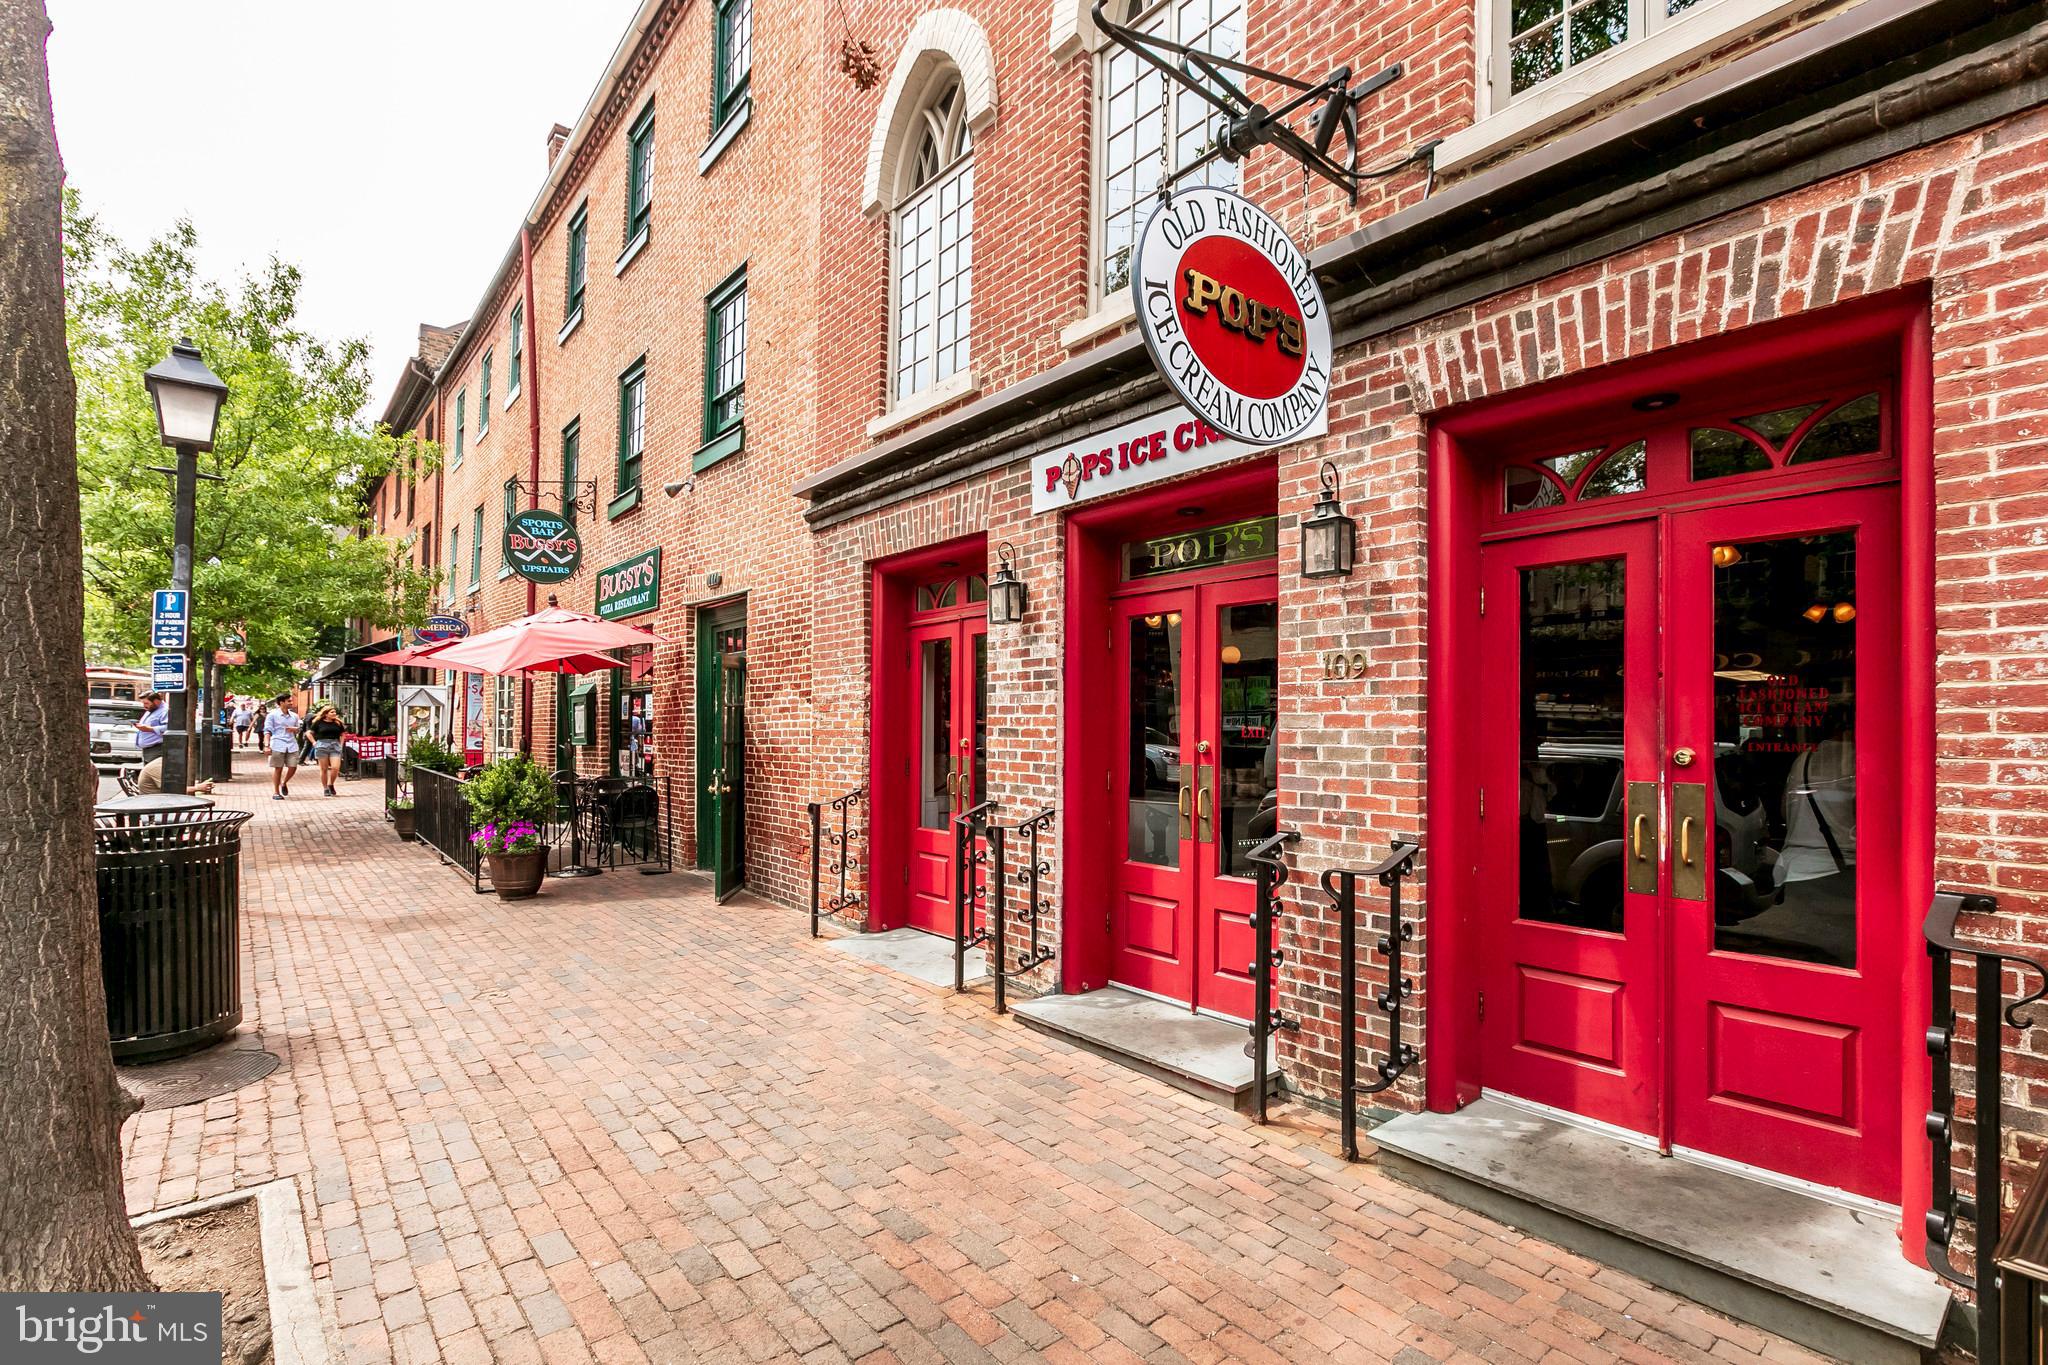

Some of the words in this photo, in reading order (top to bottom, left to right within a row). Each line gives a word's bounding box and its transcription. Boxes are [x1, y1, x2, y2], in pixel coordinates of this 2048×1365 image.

[1161, 199, 1206, 250] OLD
[1215, 197, 1319, 320] FASHIONED
[1186, 268, 1304, 355] POP'S
[1144, 276, 1179, 344] ICE
[1169, 340, 1244, 434] CREAM
[1247, 351, 1328, 439] COMPANY
[1118, 430, 1167, 470] ICE
[1173, 419, 1226, 453] CR
[521, 518, 563, 529] SPORTS
[531, 527, 556, 537] BAR
[509, 534, 578, 553] BUGSY'S
[1149, 525, 1264, 569] POP'S
[521, 565, 570, 574] UPSTAIRS
[600, 555, 654, 602] BUGSY'S
[165, 592, 176, 610] P
[614, 590, 650, 611] RESTAURANT
[1323, 652, 1367, 680] 109
[1767, 674, 1799, 686] OLD
[1739, 687, 1829, 700] FASHIONED
[1739, 701, 1765, 713] ICE
[1770, 700, 1829, 713] CREAM
[1743, 714, 1824, 728] COMPANY
[1241, 725, 1265, 738] EXIT
[1747, 743, 1818, 752] ENTRANCE
